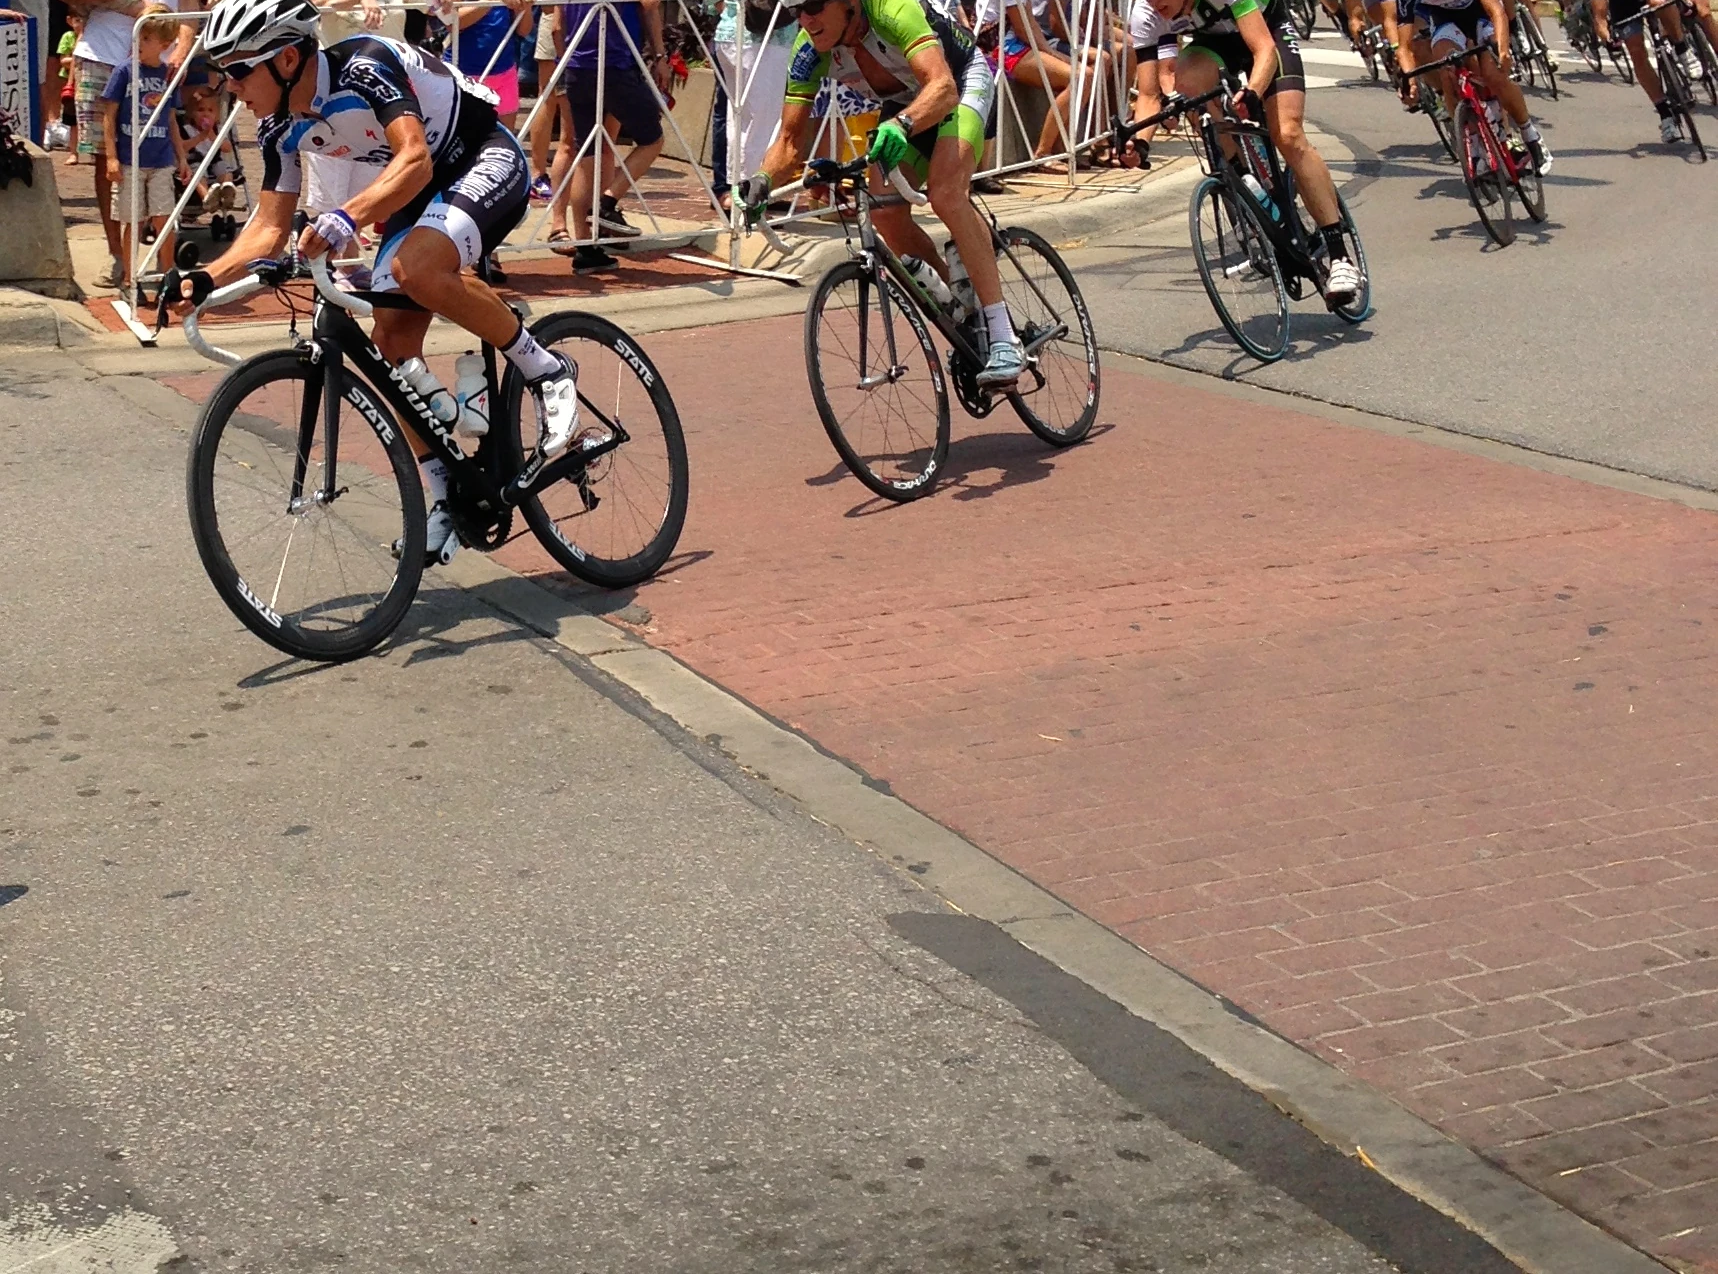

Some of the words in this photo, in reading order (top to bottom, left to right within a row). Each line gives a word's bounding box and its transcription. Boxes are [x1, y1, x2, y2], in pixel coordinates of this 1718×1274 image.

[614, 338, 655, 388] STATE
[347, 386, 396, 446] STATE
[236, 577, 283, 629] STATE
